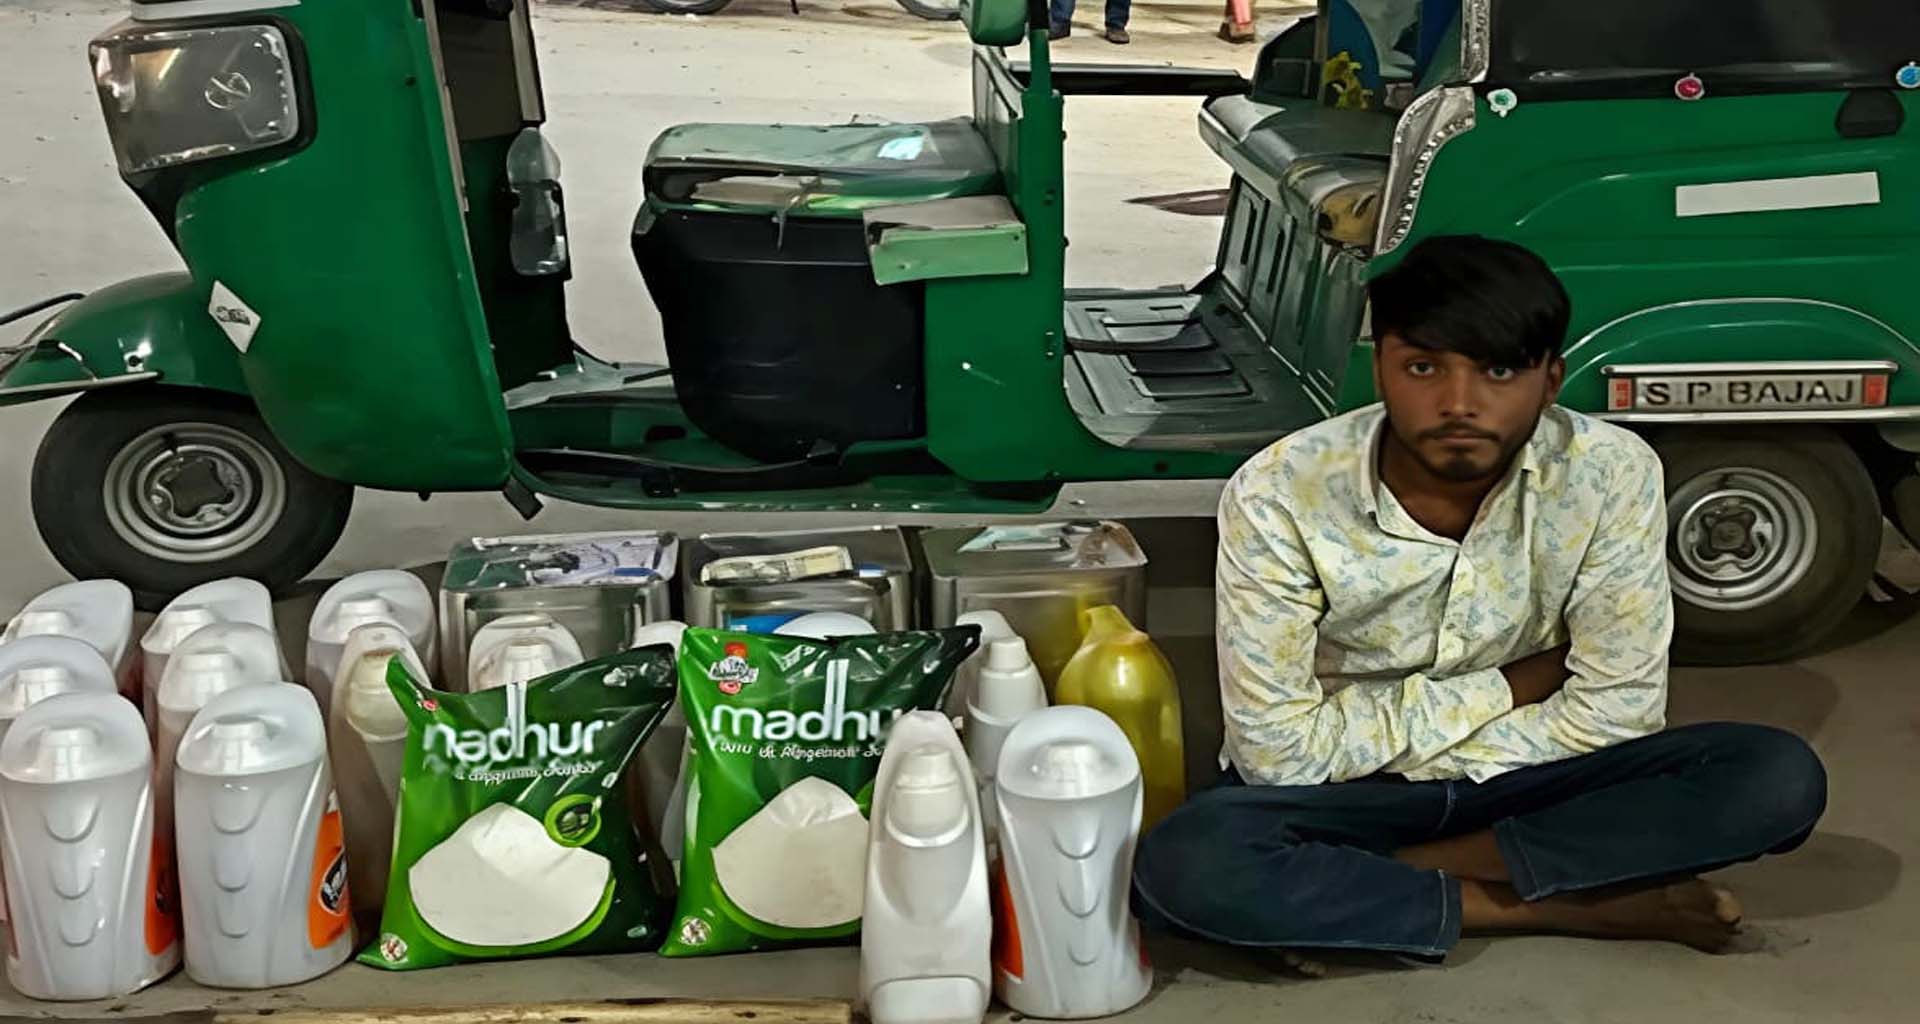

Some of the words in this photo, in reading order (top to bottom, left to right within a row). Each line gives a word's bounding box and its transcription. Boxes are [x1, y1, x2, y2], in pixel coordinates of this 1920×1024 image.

[1645, 381, 1671, 406] S
[1687, 381, 1712, 405] P
[1727, 379, 1855, 405] BAJAJ
